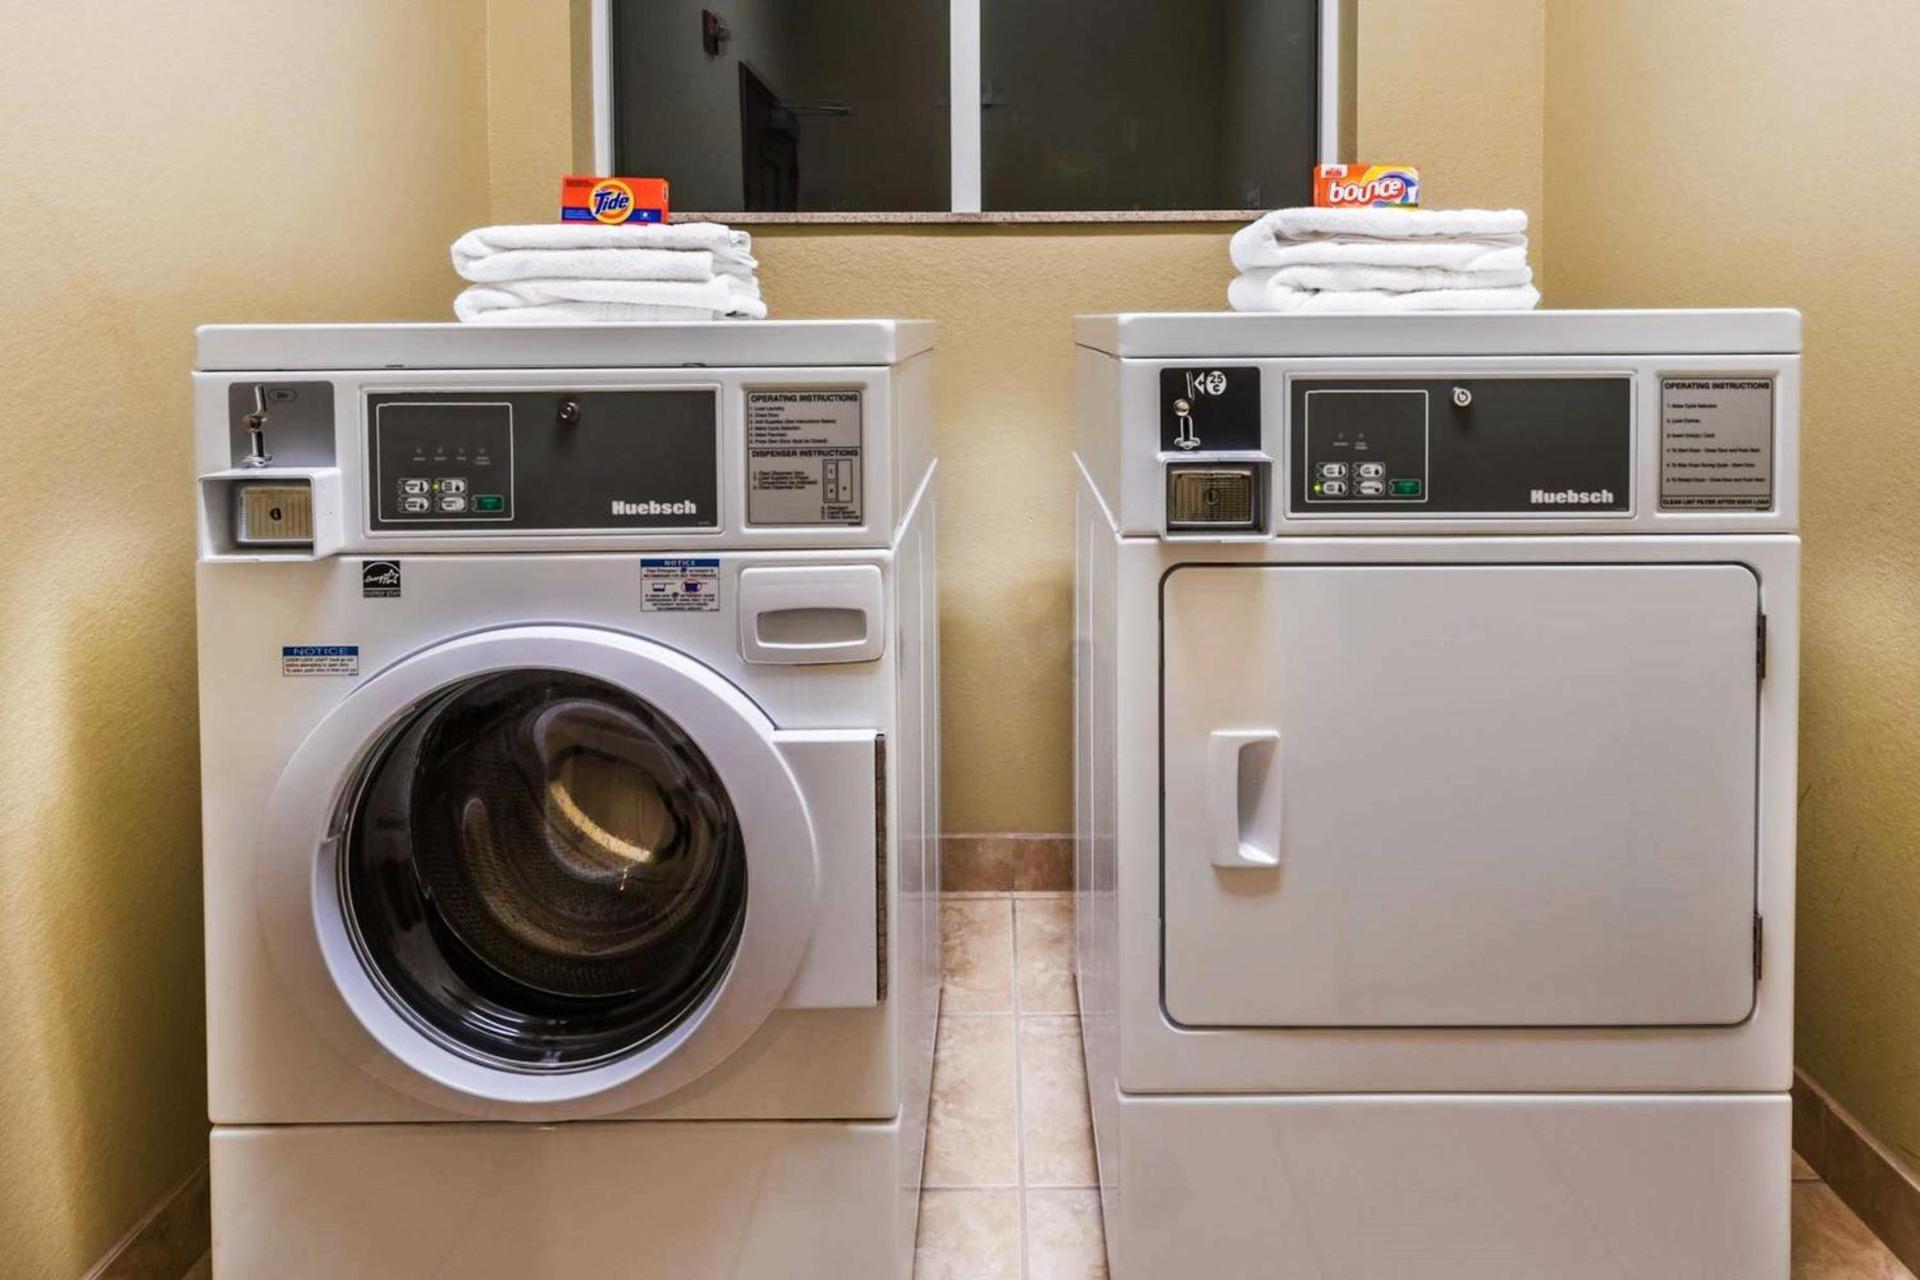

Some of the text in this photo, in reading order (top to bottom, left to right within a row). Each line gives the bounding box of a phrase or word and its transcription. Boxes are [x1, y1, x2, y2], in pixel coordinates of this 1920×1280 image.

[1329, 180, 1402, 203] bounce
[594, 191, 630, 215] Tide
[1208, 374, 1224, 384] 25
[800, 394, 858, 402] INSTRUCTIONS
[752, 449, 858, 458] DISPENSER INSTRUCTIONS
[1530, 489, 1614, 504] Huebsch
[611, 499, 697, 515] Huebsch
[293, 648, 348, 656] NOTICE
